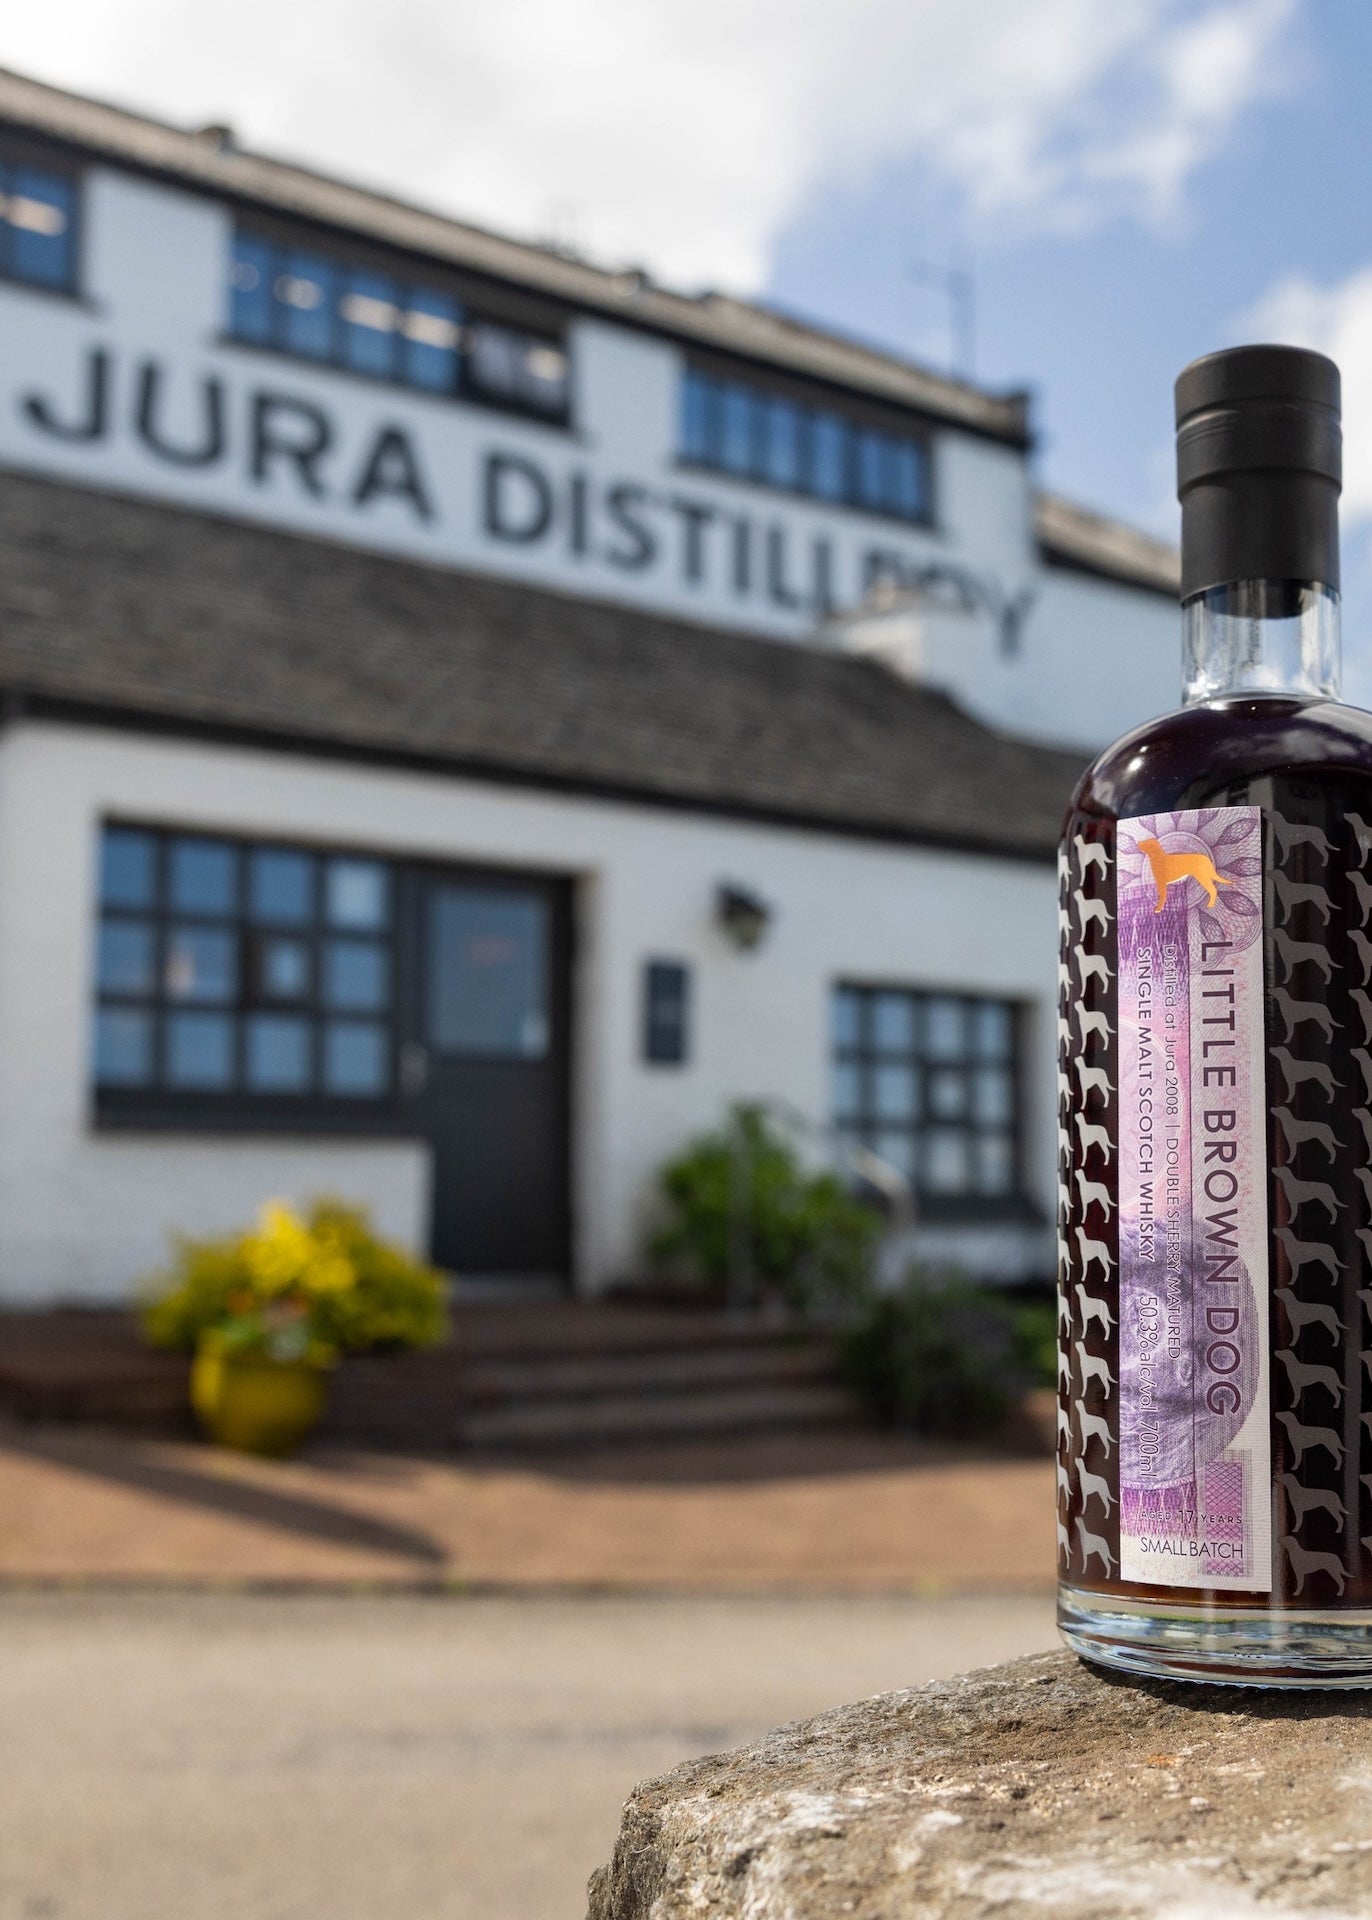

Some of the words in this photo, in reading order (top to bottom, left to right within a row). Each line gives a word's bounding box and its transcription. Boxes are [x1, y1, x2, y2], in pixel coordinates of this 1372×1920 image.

[22, 348, 438, 525] JURA
[1137, 947, 1152, 1020] SINGLE
[1164, 945, 1178, 1007] Distilled
[1164, 1013, 1177, 1030] at
[1201, 941, 1236, 1087] LITTLE
[1138, 1026, 1153, 1080] MALT
[1165, 1037, 1177, 1071] Jura
[1165, 1077, 1179, 1116] 2008
[1138, 1087, 1153, 1174] SCOTCH
[1166, 1138, 1180, 1206] DOUBLE
[1203, 1110, 1239, 1283] BROWN
[1139, 1181, 1155, 1262] WHISKY
[1166, 1211, 1181, 1273] SHERRY
[1139, 1297, 1159, 1347] 50.3%
[1167, 1278, 1182, 1360] MATURED
[1139, 1352, 1159, 1413] alc/vol
[1206, 1307, 1242, 1416] DOG
[1140, 1422, 1159, 1478] 700ml
[1141, 1512, 1172, 1521] AGED
[1178, 1510, 1194, 1525] 17
[1200, 1514, 1243, 1525] YEARS
